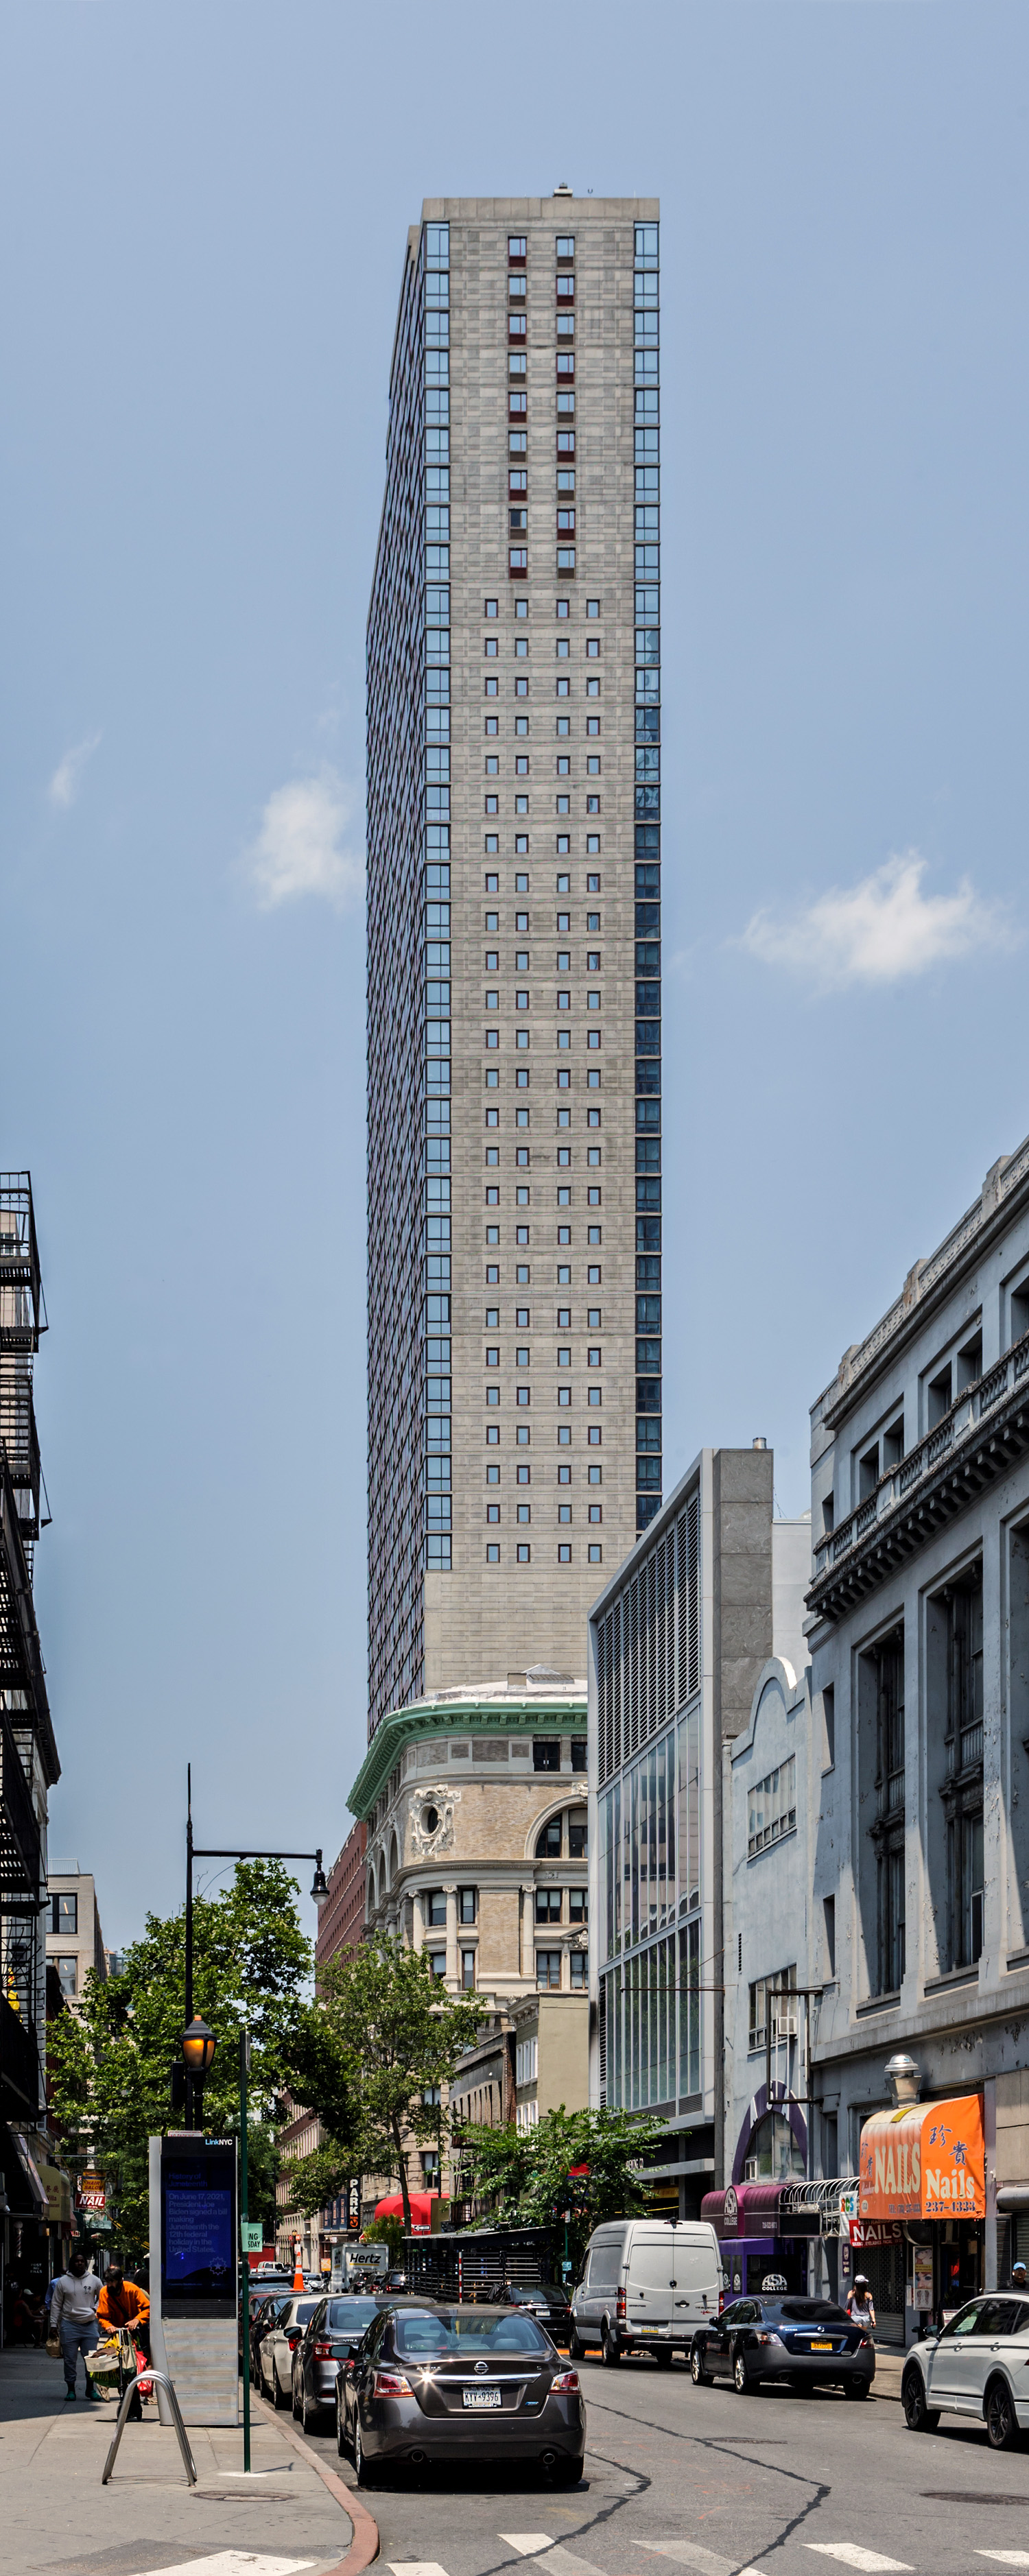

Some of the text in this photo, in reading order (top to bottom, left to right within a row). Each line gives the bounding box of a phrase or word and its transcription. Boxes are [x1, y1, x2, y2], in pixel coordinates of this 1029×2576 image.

[875, 2142, 921, 2195] NAILS
[925, 2169, 975, 2199] Nails
[79, 2196, 104, 2206] NAIL
[350, 2179, 359, 2215] PARK
[925, 2201, 975, 2212] 237-4333
[853, 2222, 901, 2242] NAILS
[350, 2253, 381, 2263] Hertz
[761, 2274, 788, 2286] ASA
